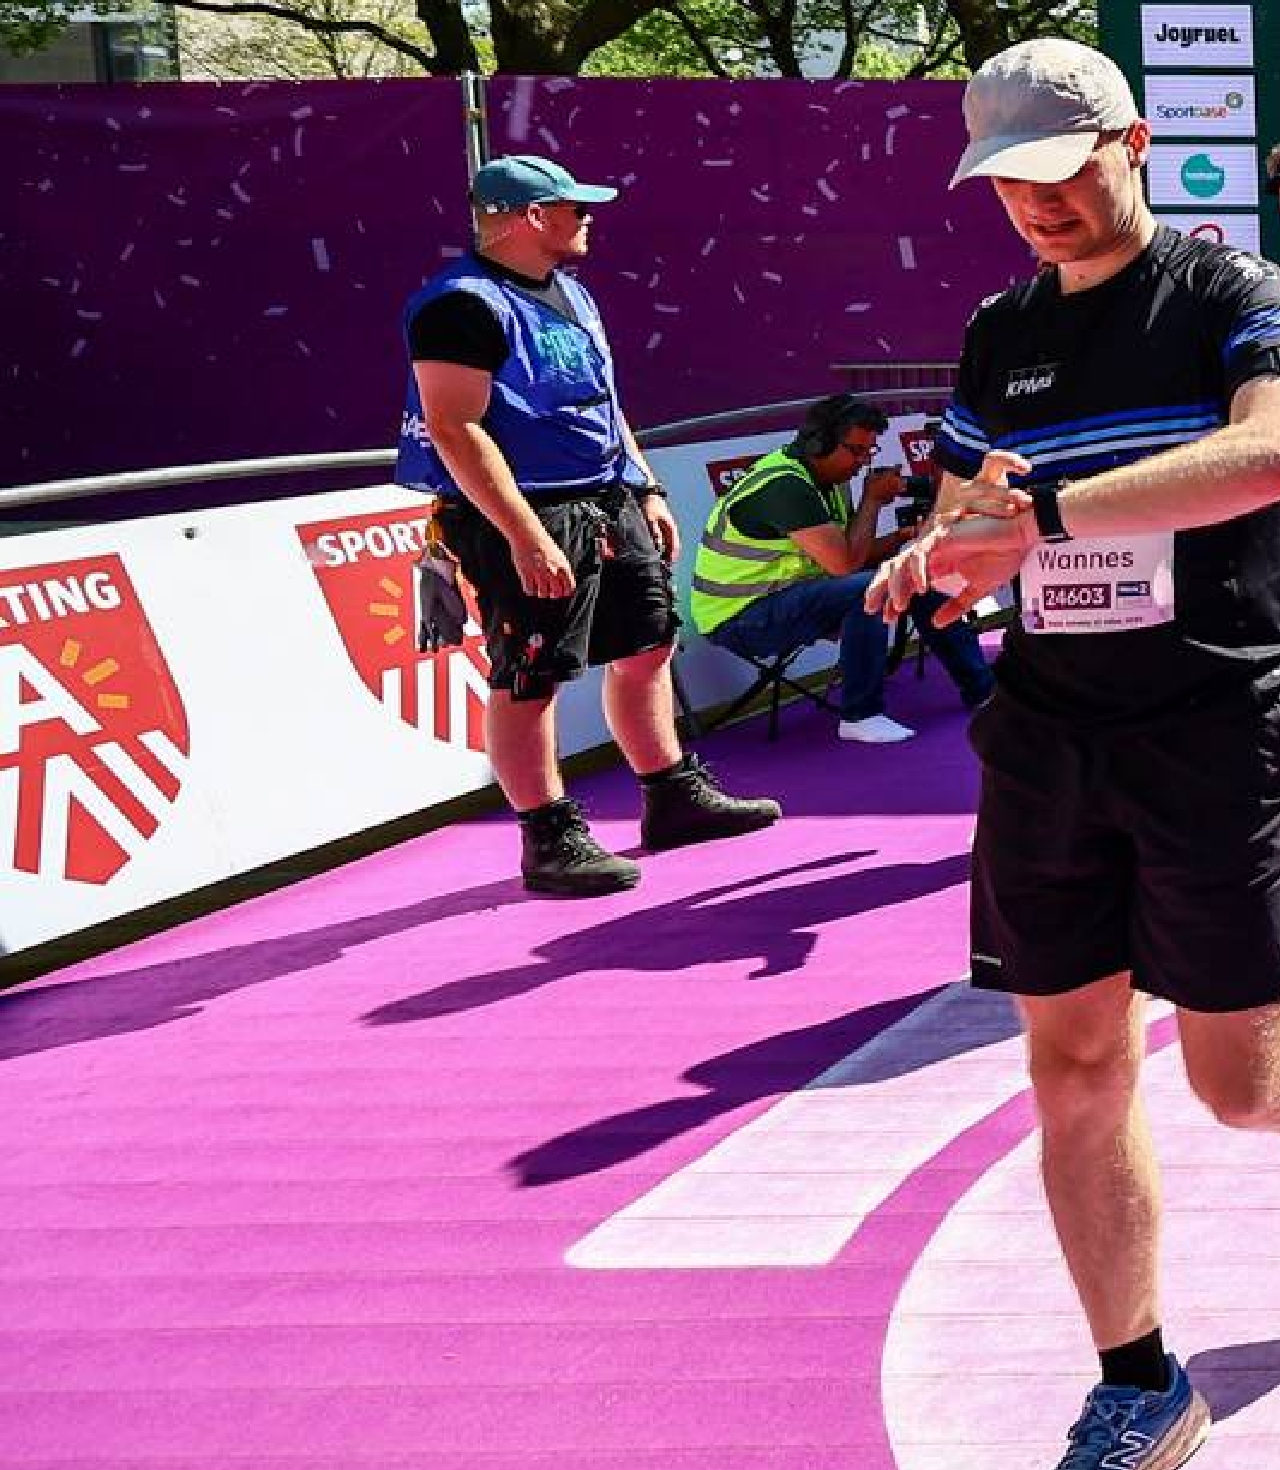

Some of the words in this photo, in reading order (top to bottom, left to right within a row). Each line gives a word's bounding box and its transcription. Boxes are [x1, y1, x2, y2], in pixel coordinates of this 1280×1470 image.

[317, 519, 428, 568] SPORT
[1037, 549, 1134, 573] Wannes
[1045, 586, 1106, 606] 24603
